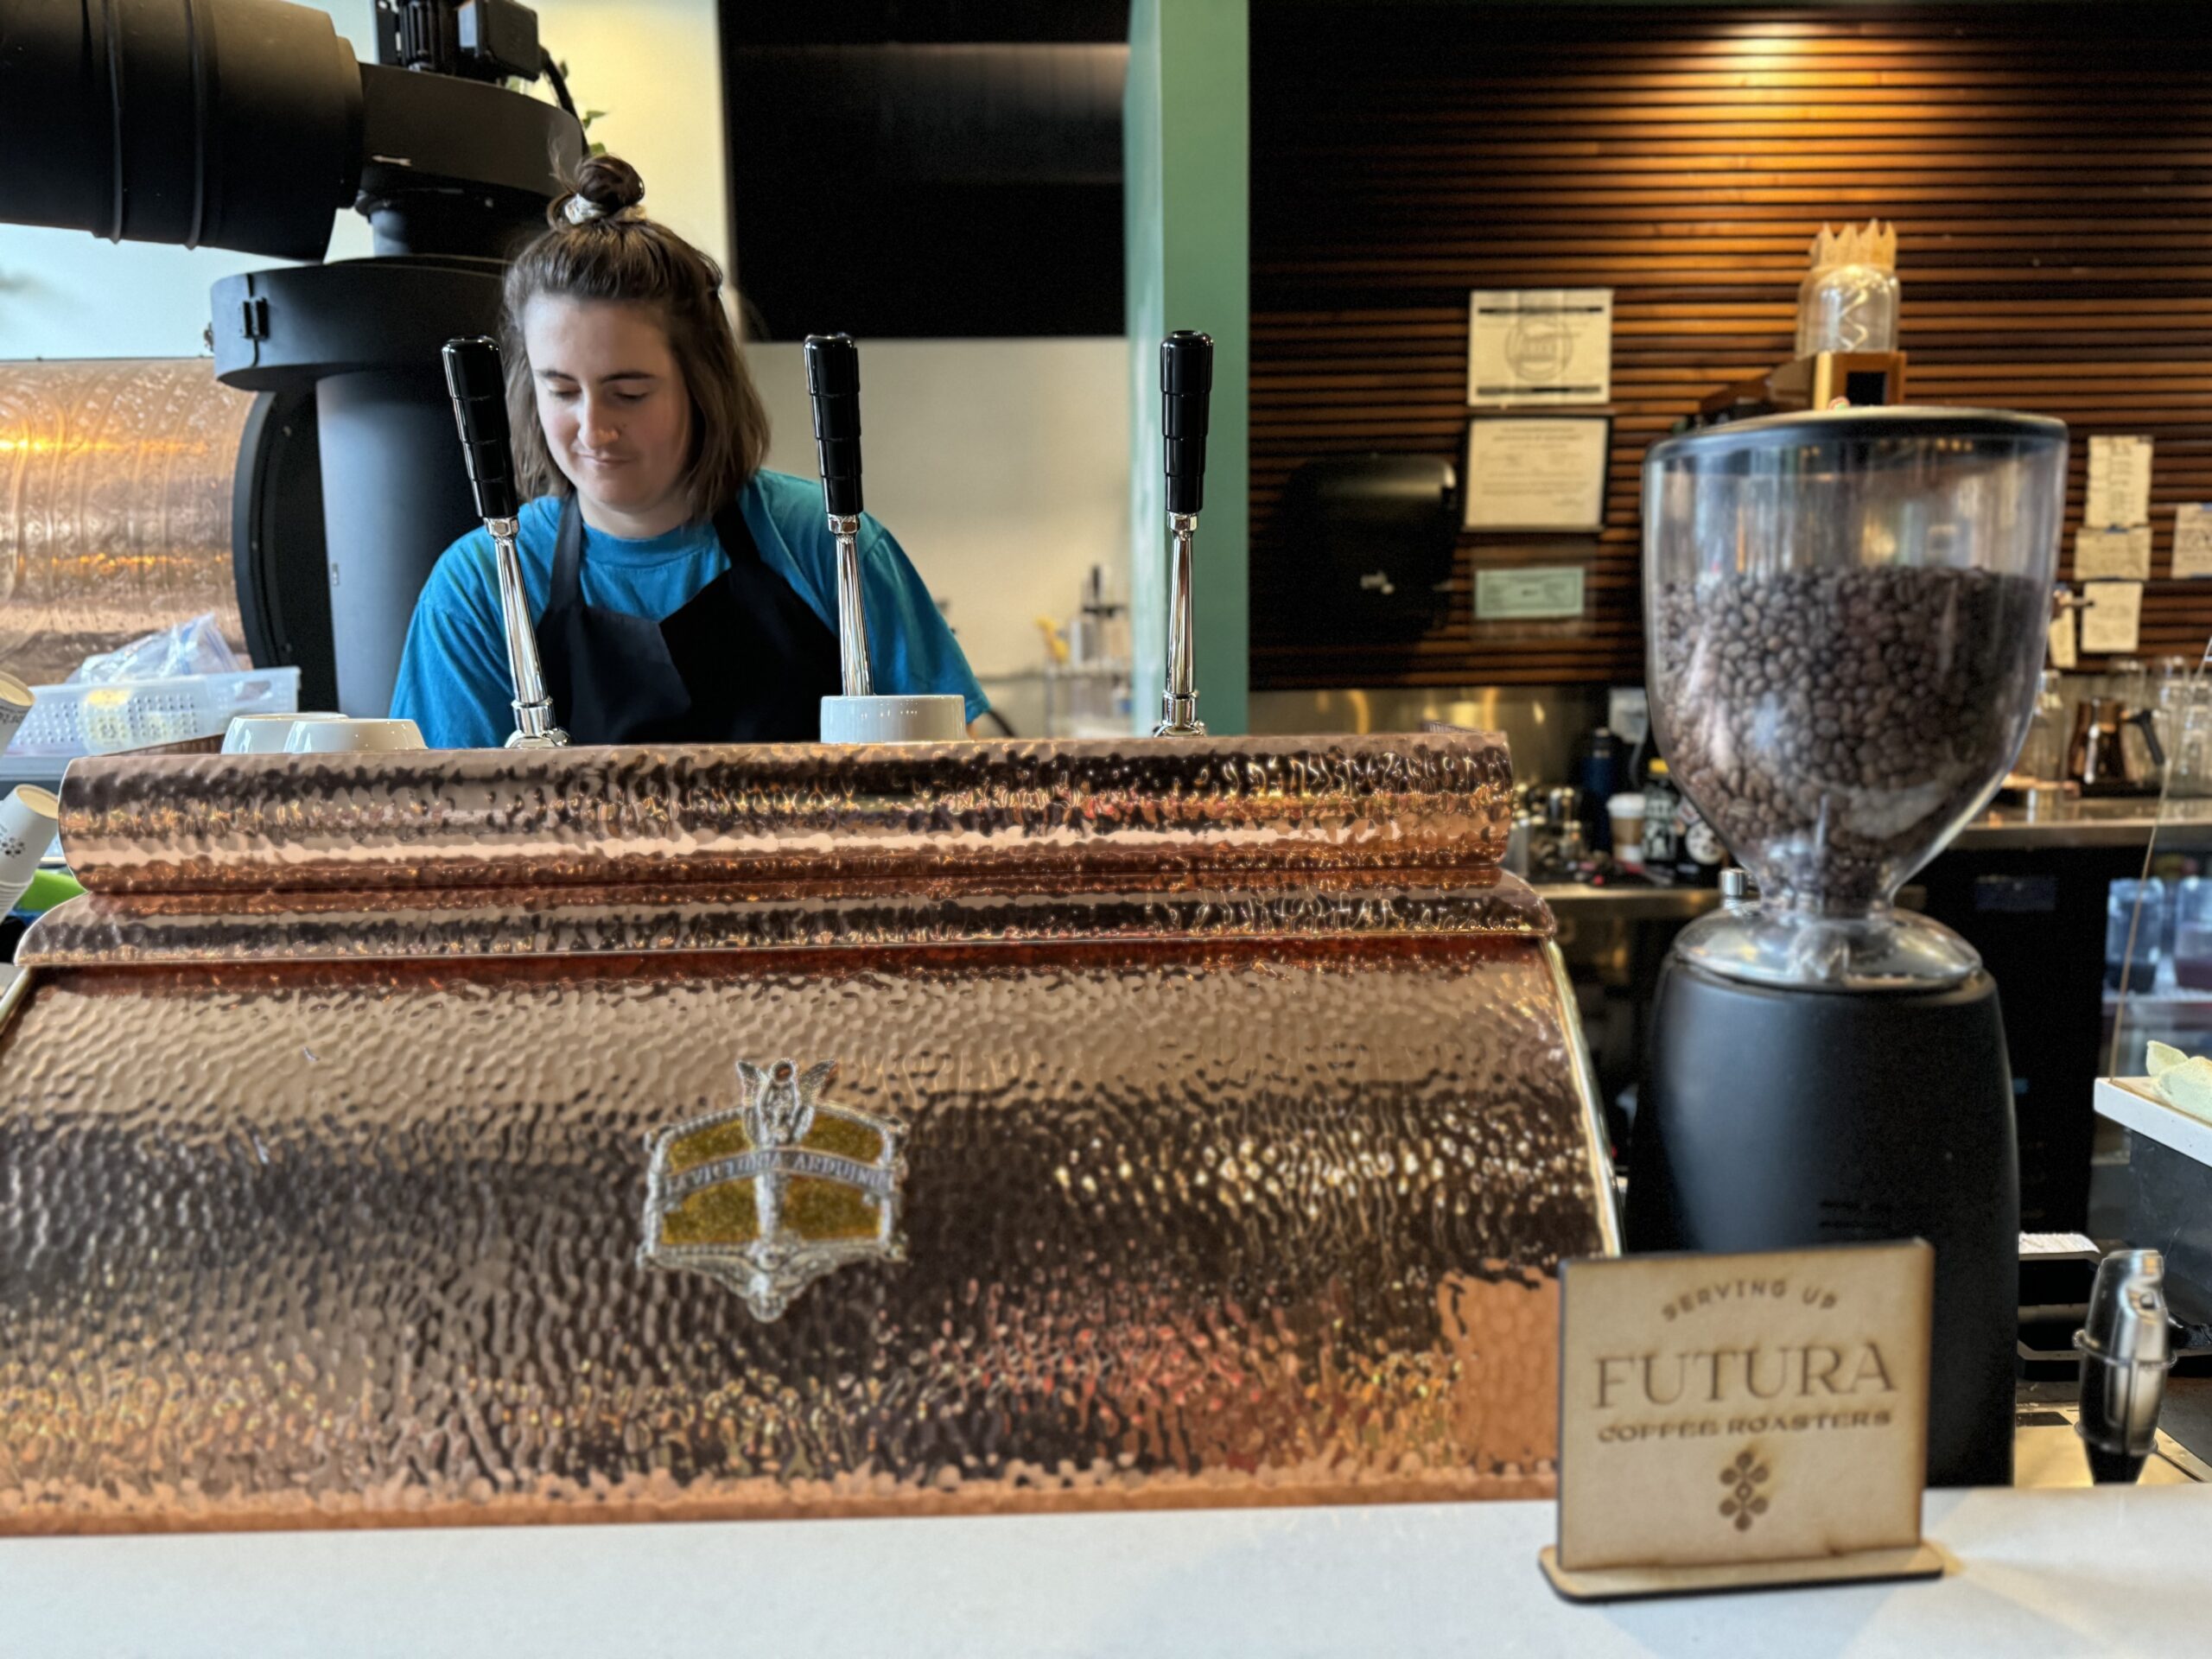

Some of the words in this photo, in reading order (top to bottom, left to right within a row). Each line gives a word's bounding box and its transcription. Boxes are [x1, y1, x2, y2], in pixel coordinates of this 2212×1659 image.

[1662, 1280, 1788, 1322] SERVING
[1802, 1287, 1838, 1310] UP
[1594, 1342, 1898, 1409] FUTURA
[1598, 1420, 1719, 1443] COFFEE
[1727, 1410, 1893, 1435] ROASTERS
